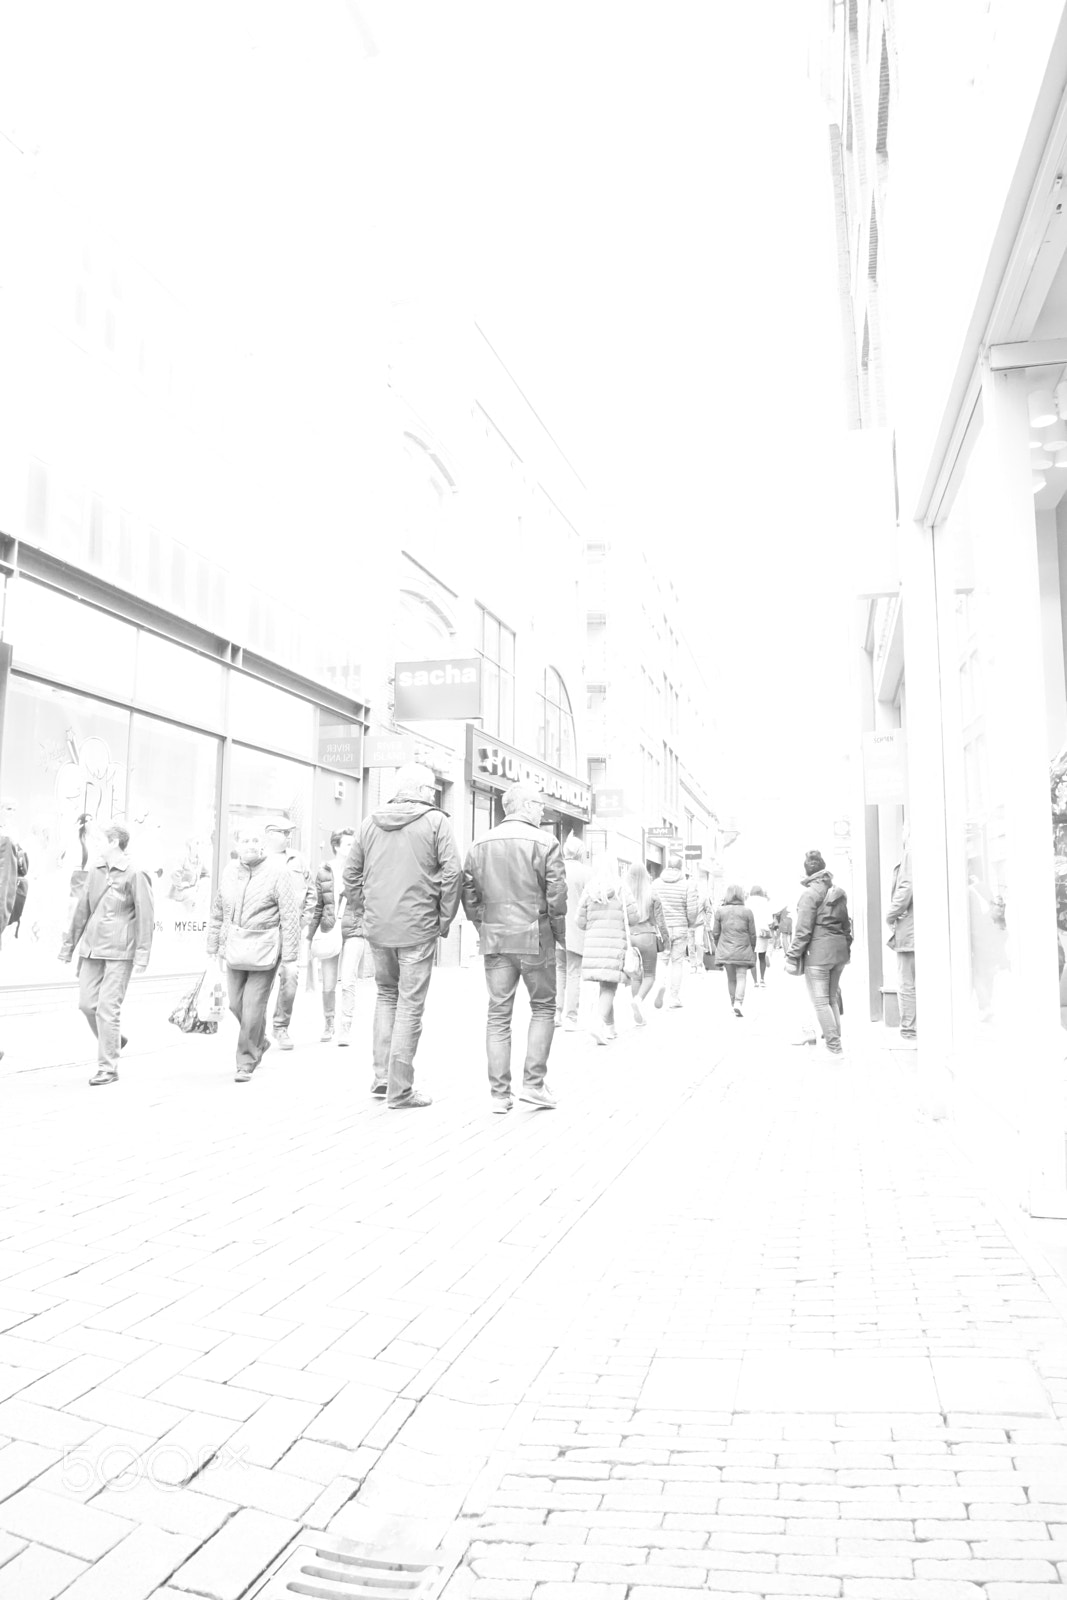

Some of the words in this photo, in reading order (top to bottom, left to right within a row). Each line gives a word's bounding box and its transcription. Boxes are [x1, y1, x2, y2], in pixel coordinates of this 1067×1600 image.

[398, 664, 477, 687] sacha
[505, 755, 545, 793] UNDER
[544, 772, 589, 811] ARMOUR
[174, 920, 207, 932] MYSELF
